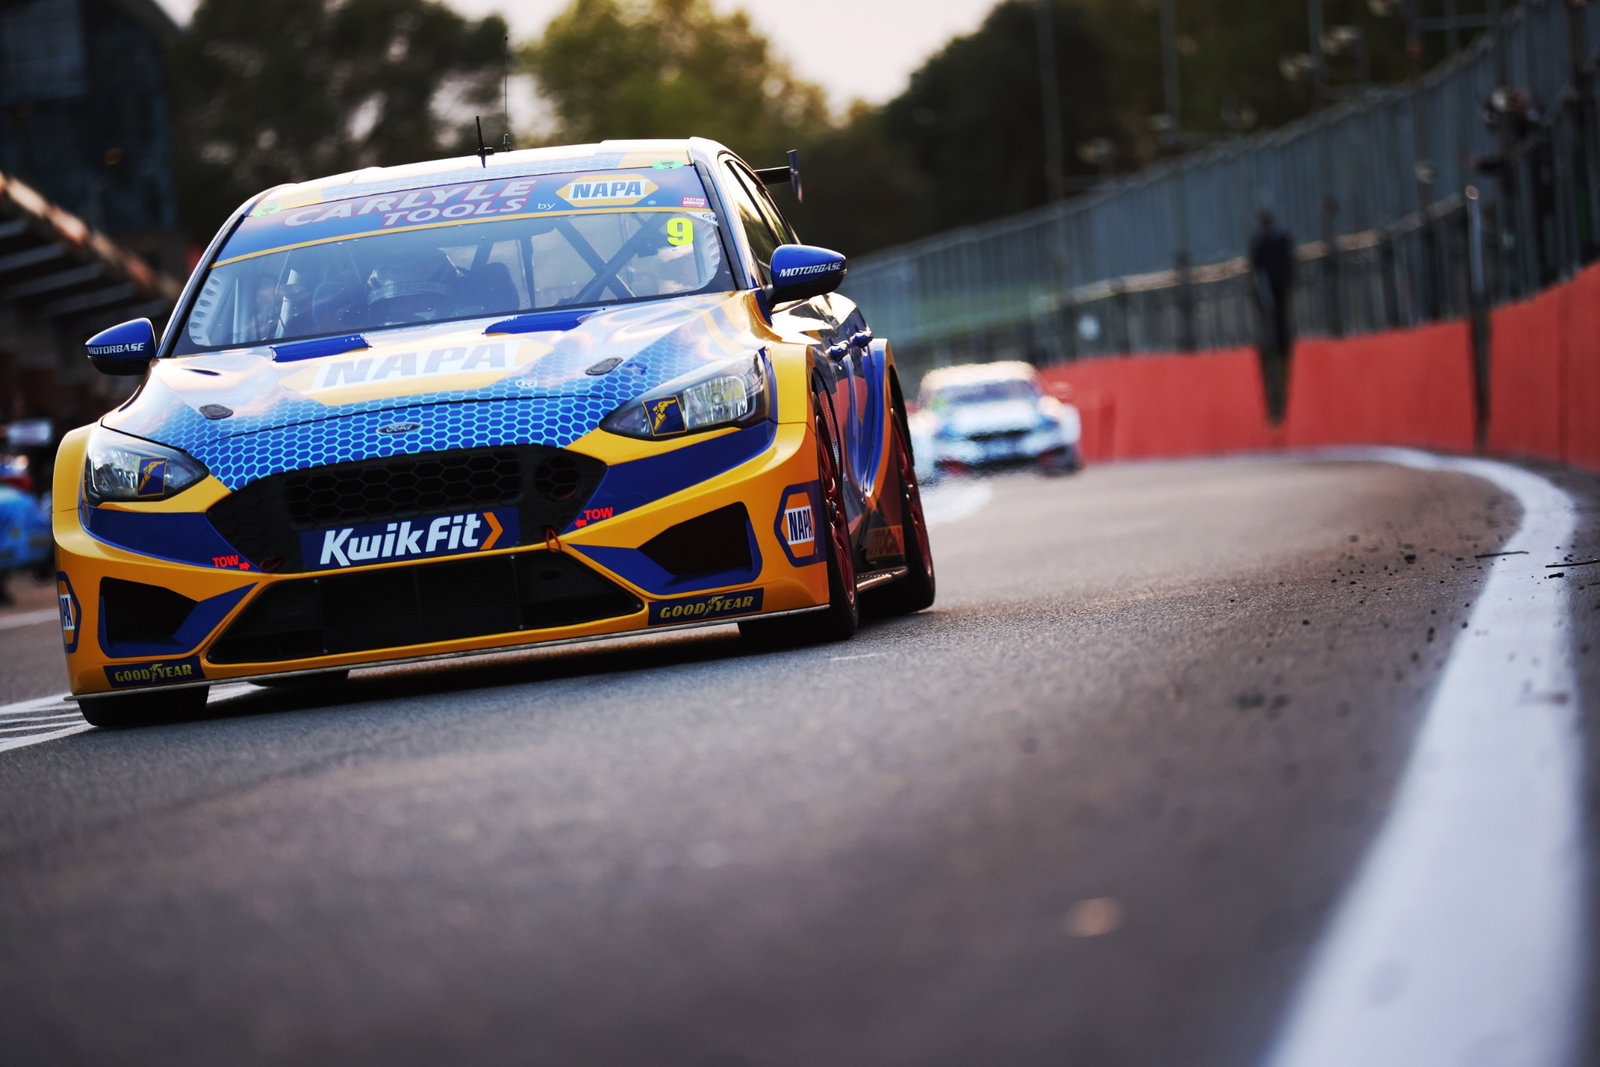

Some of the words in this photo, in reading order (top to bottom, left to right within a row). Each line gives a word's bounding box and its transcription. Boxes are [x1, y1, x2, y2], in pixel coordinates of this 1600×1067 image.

[572, 180, 642, 199] NAPA
[283, 180, 537, 227] CARLYLE
[383, 198, 526, 227] TOOLS
[537, 203, 555, 211] by
[666, 217, 694, 246] 9
[779, 262, 842, 278] MOTORBASE
[88, 342, 145, 355] MOTORBASE
[322, 341, 507, 388] NAPA
[584, 507, 613, 521] TOW
[788, 508, 813, 541] NAPA
[212, 555, 239, 568] TOW
[659, 595, 754, 619] GOODYEAR
[114, 663, 193, 683] GOODYEAR
